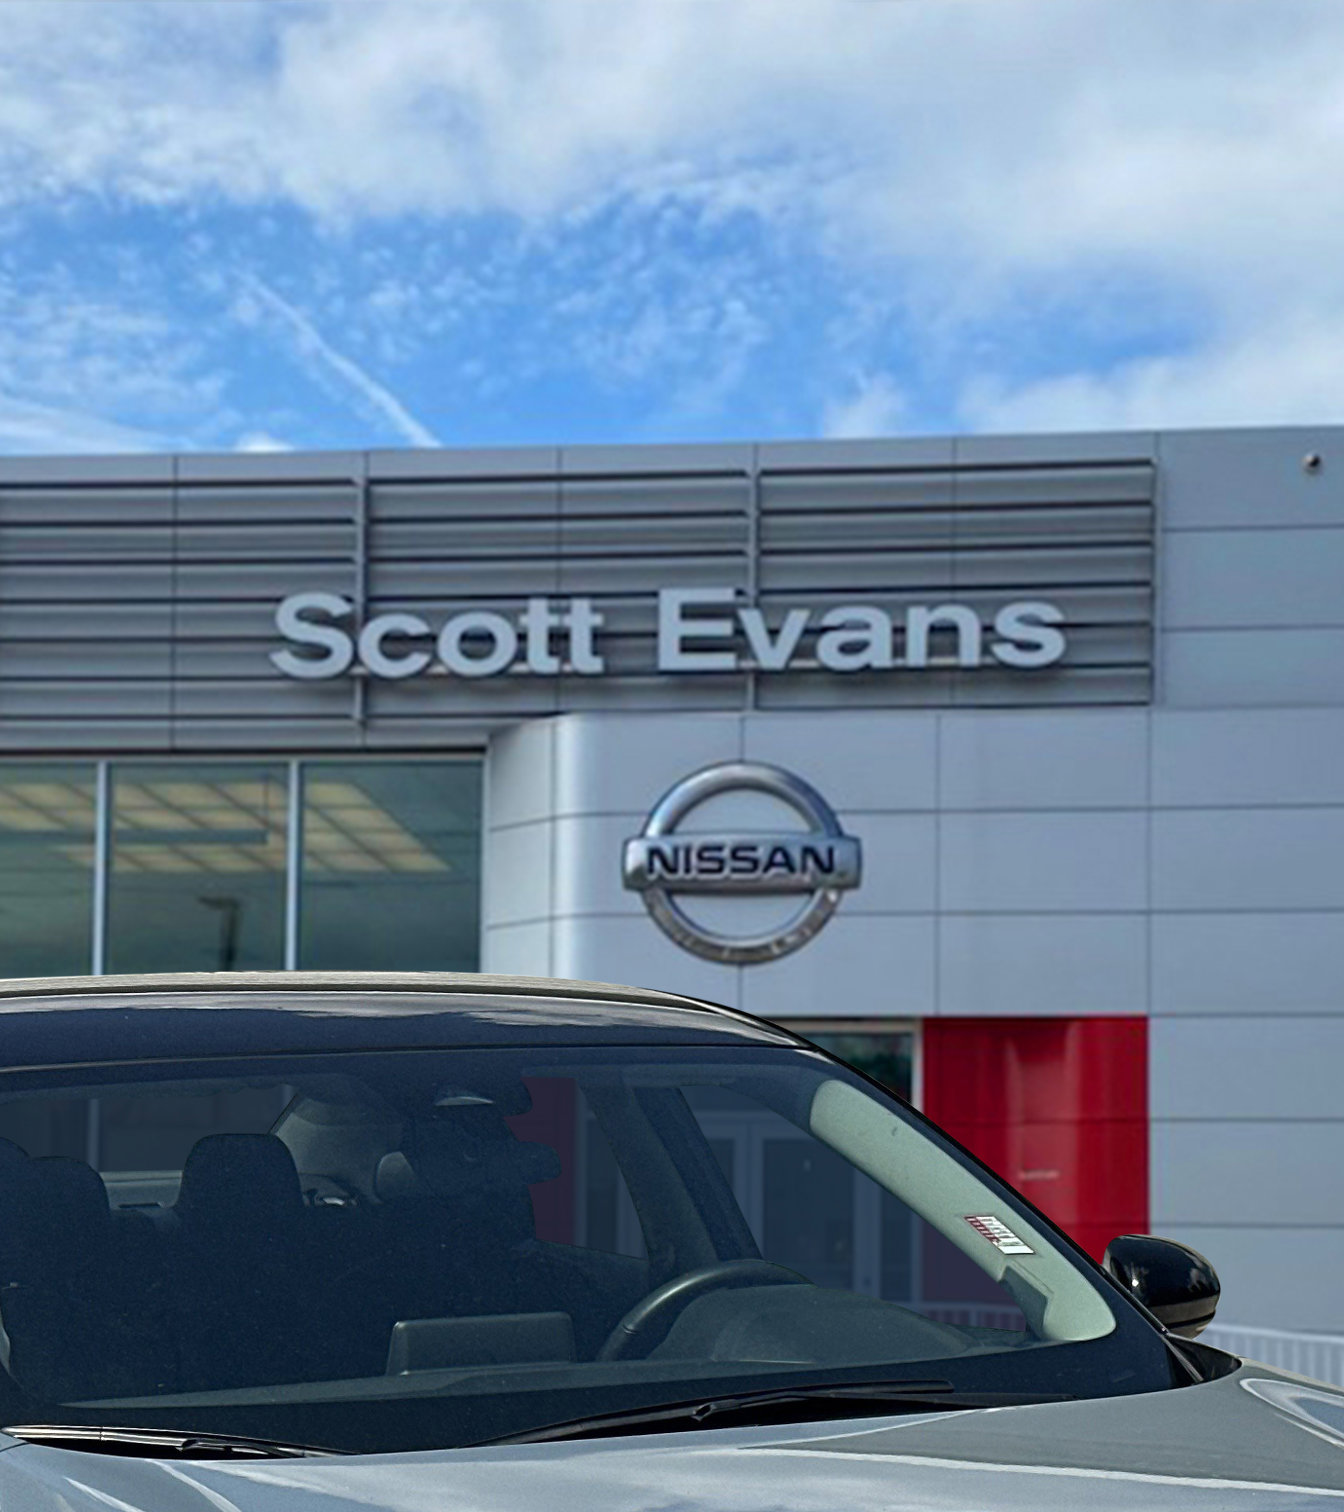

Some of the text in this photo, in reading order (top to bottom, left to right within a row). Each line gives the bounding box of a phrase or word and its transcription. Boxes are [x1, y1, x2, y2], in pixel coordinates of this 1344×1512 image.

[269, 586, 1069, 680] Scott Evans
[645, 844, 835, 876] NISSAN
